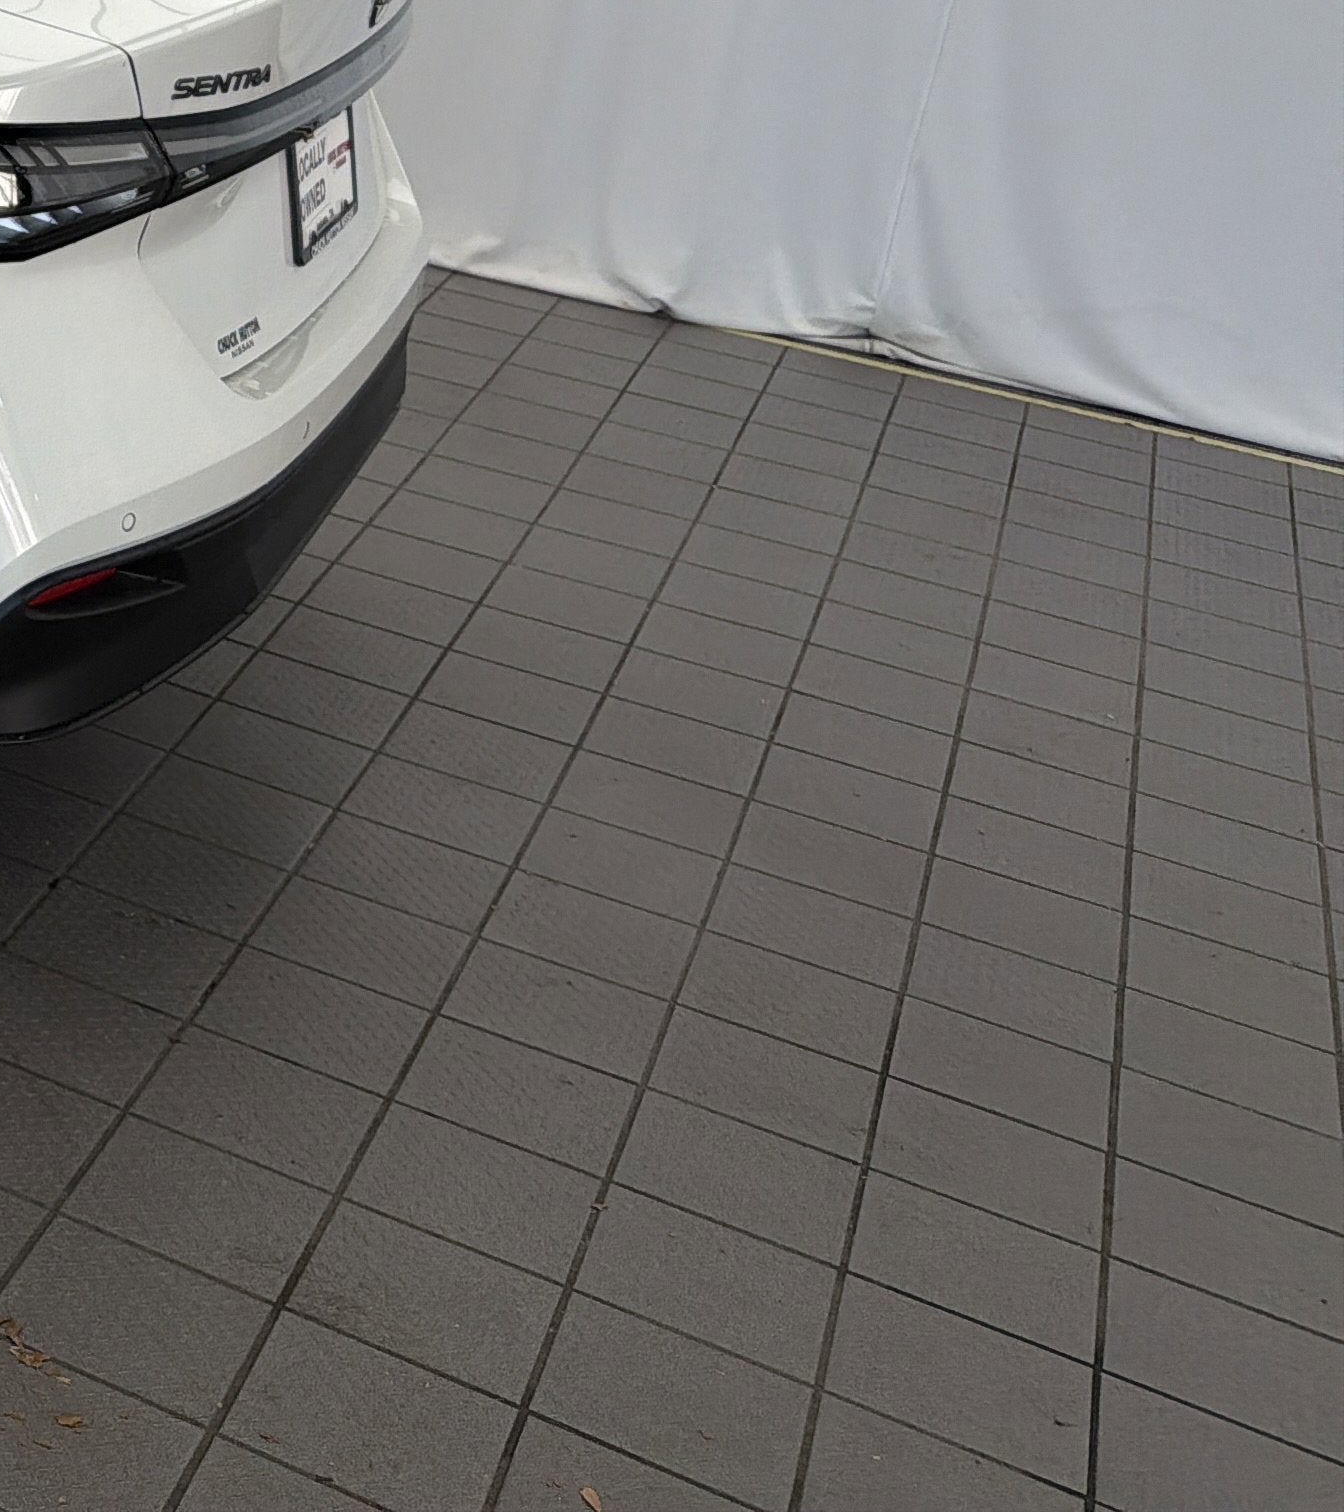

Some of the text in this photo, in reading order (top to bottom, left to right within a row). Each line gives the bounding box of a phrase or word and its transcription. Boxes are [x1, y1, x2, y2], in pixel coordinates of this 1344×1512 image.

[171, 64, 272, 101] SENTRA
[297, 137, 327, 183] OCALLY
[231, 338, 255, 359] NISSAN
